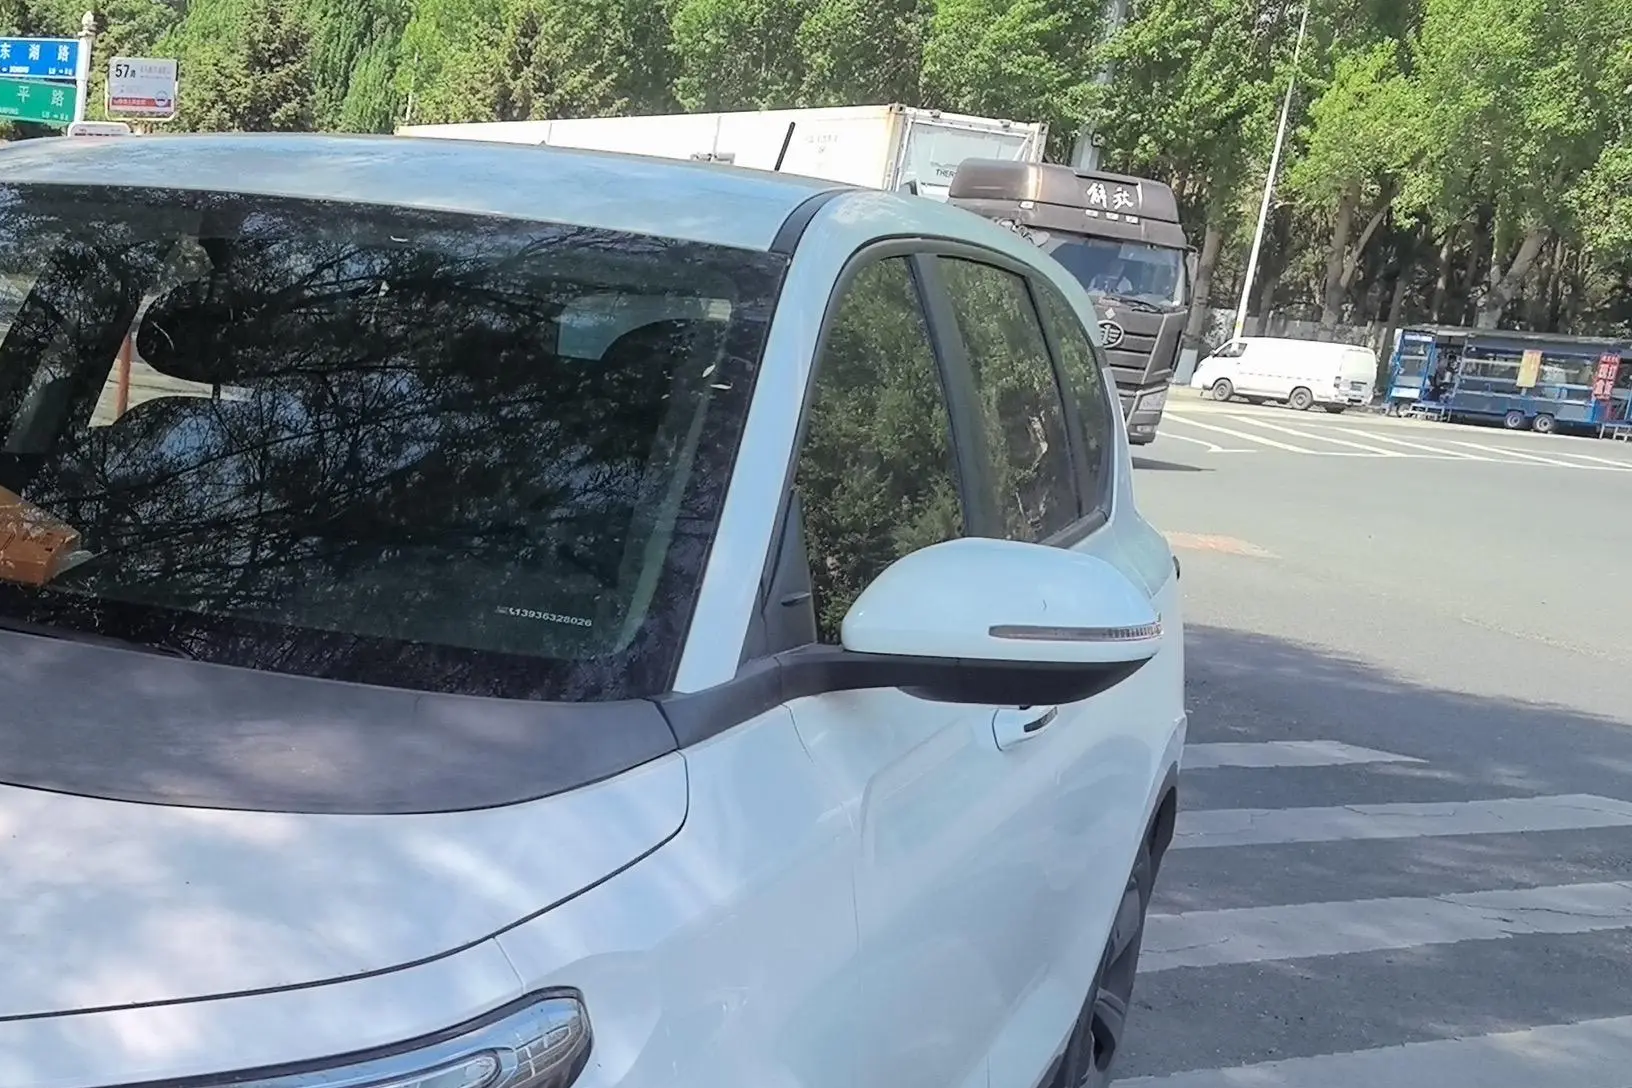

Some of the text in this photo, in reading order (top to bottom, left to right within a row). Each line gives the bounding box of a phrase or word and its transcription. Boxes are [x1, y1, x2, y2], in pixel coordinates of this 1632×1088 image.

[0, 42, 70, 62] 东湖路
[1086, 182, 1135, 210] 解放
